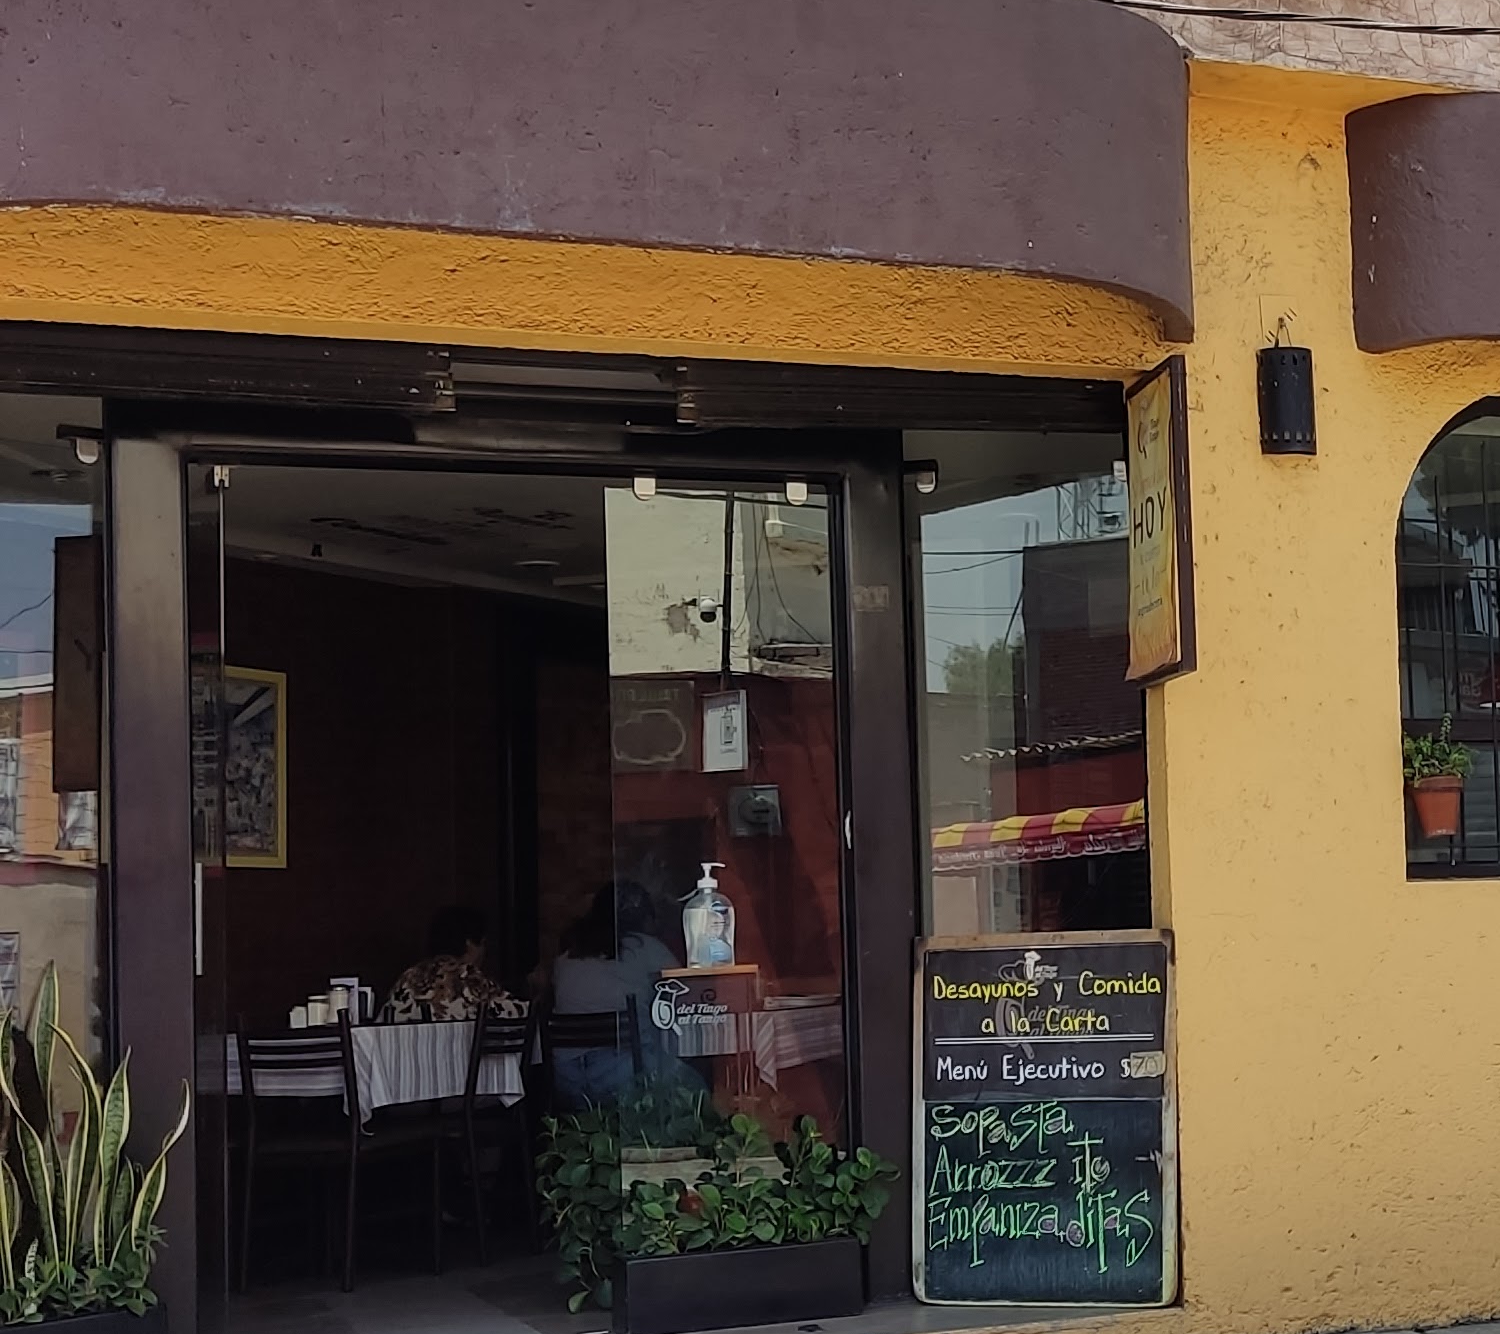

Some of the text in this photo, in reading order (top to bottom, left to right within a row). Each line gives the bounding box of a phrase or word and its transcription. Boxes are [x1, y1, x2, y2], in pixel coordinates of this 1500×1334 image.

[1133, 487, 1166, 548] HOY
[933, 975, 1038, 1005] Desayunos
[1054, 980, 1063, 1001] y
[1079, 971, 1162, 996] Comida
[697, 1003, 728, 1016] Tingo
[981, 1017, 995, 1034] a
[1010, 1011, 1030, 1034] la
[1045, 1008, 1109, 1033] Carta
[937, 1056, 988, 1081] Menú
[1002, 1054, 1105, 1086] Ejecutivo
[928, 1144, 1057, 1197] Arrozzz
